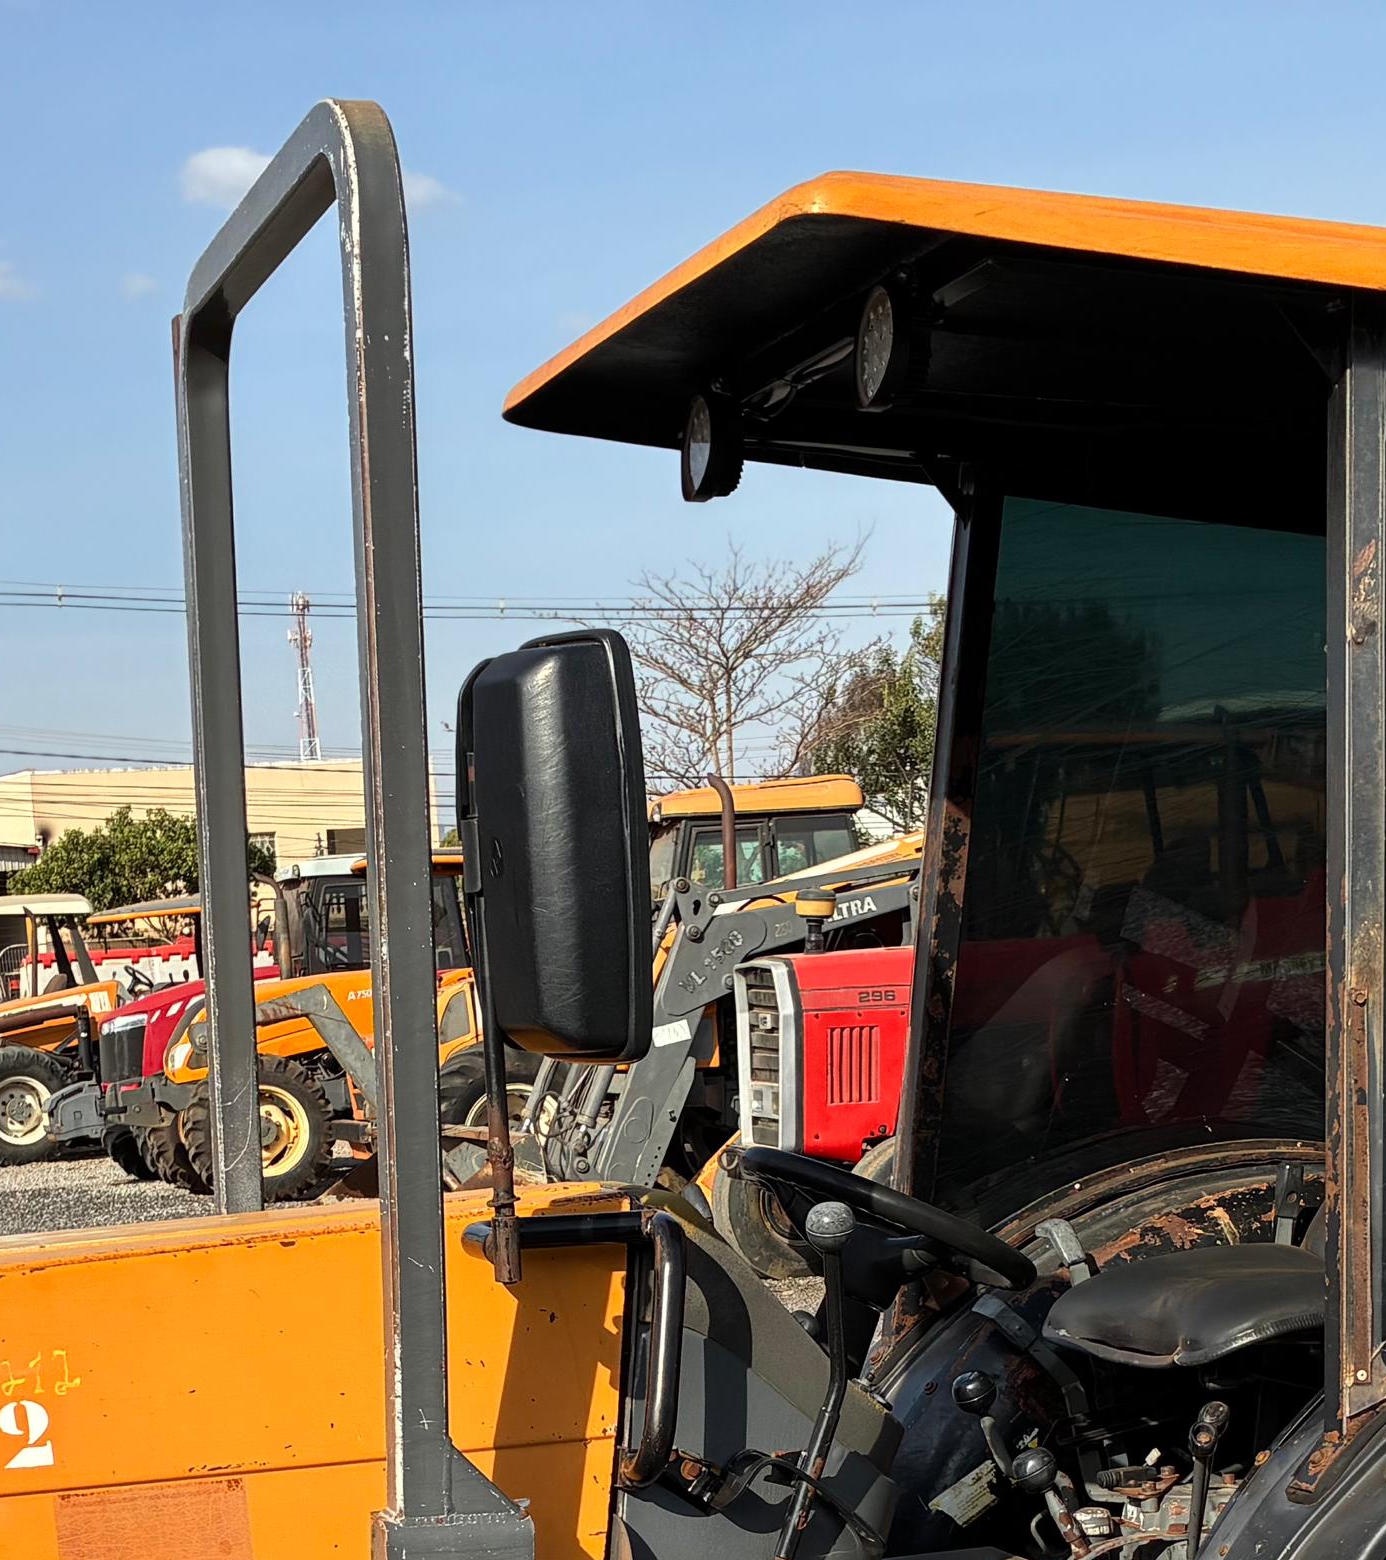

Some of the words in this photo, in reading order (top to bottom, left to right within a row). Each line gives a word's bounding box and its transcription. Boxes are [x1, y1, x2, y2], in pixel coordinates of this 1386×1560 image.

[827, 896, 877, 922] LTRA
[857, 990, 896, 1003] 296
[0, 1350, 82, 1396] 212
